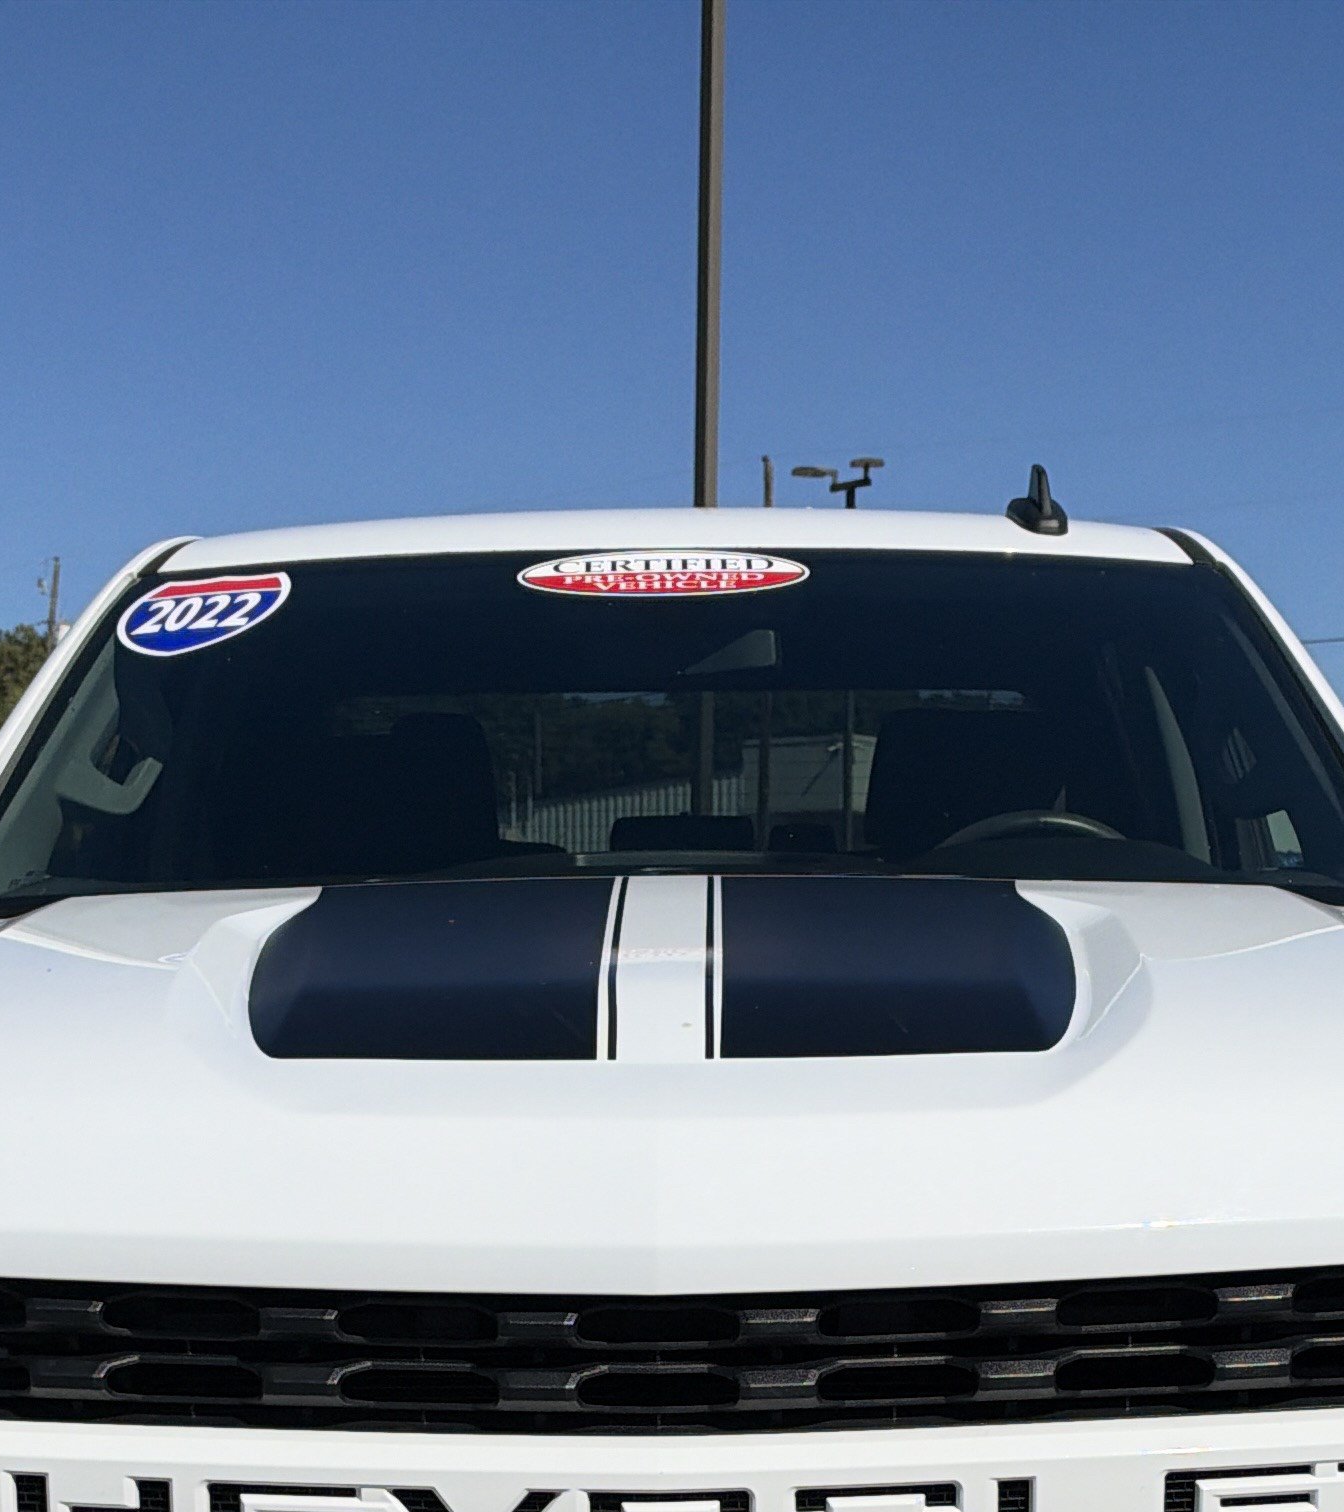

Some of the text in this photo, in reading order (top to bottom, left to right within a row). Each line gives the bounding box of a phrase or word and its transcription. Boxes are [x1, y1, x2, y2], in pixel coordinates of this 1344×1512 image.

[552, 557, 774, 574] CERTIFIED
[562, 571, 766, 586] PRE-OWNED
[592, 580, 738, 591] VEHICLE
[130, 592, 262, 636] 2022
